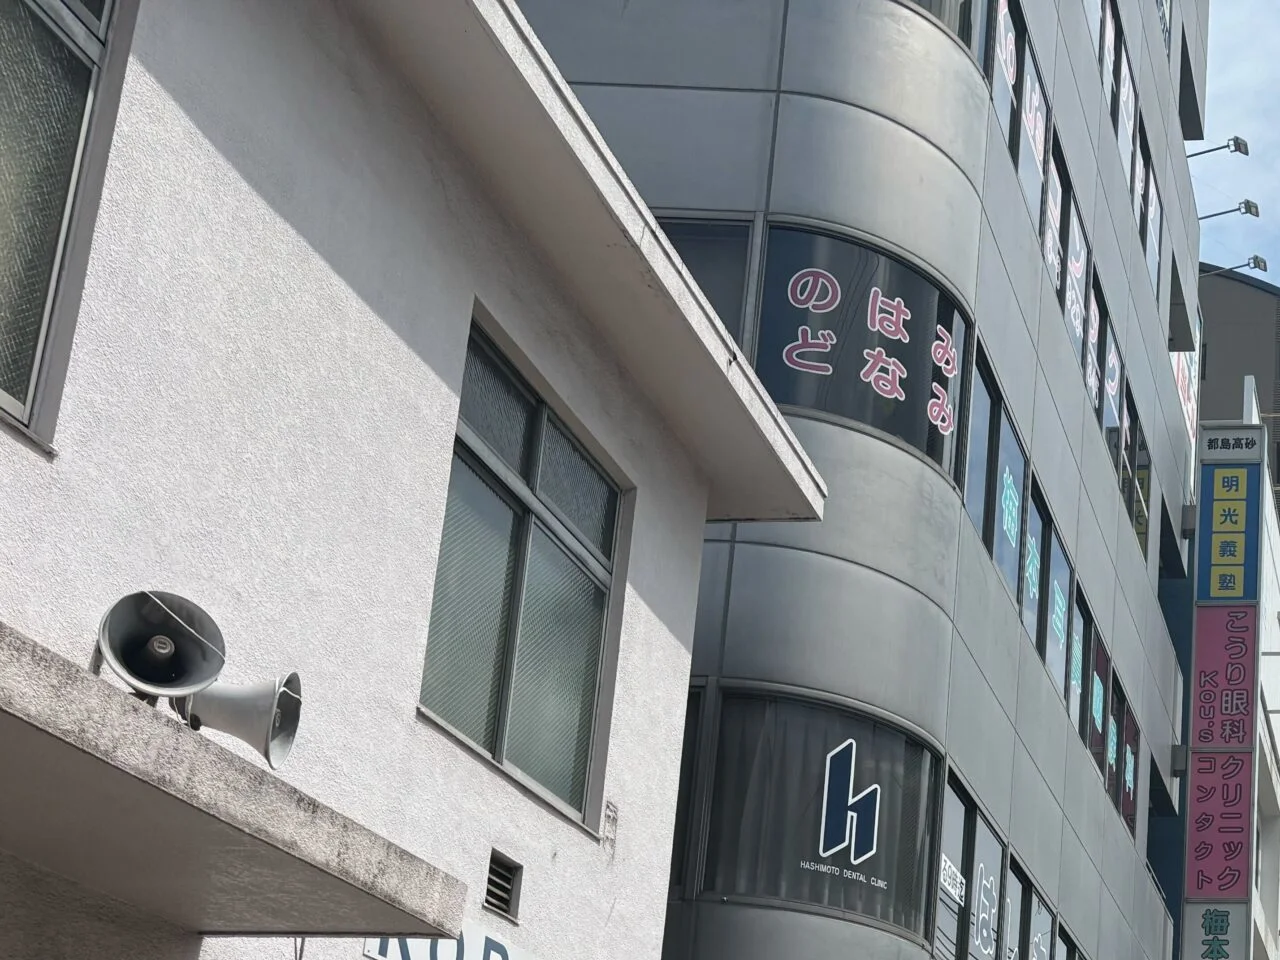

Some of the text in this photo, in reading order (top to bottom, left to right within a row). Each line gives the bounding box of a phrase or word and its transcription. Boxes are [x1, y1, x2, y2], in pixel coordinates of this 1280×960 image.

[783, 268, 841, 375] のど
[860, 286, 912, 401] はな
[927, 324, 958, 435] みみ
[1207, 438, 1256, 450] 都島高砂
[1218, 475, 1240, 590] 明光義塾
[1199, 670, 1218, 742] Kou's
[1220, 611, 1248, 743] こうり眼科
[800, 860, 888, 890] HASHIMOTO DENTAL CLINIC
[1194, 757, 1216, 890] コンタクト
[1218, 756, 1244, 891] クリニック
